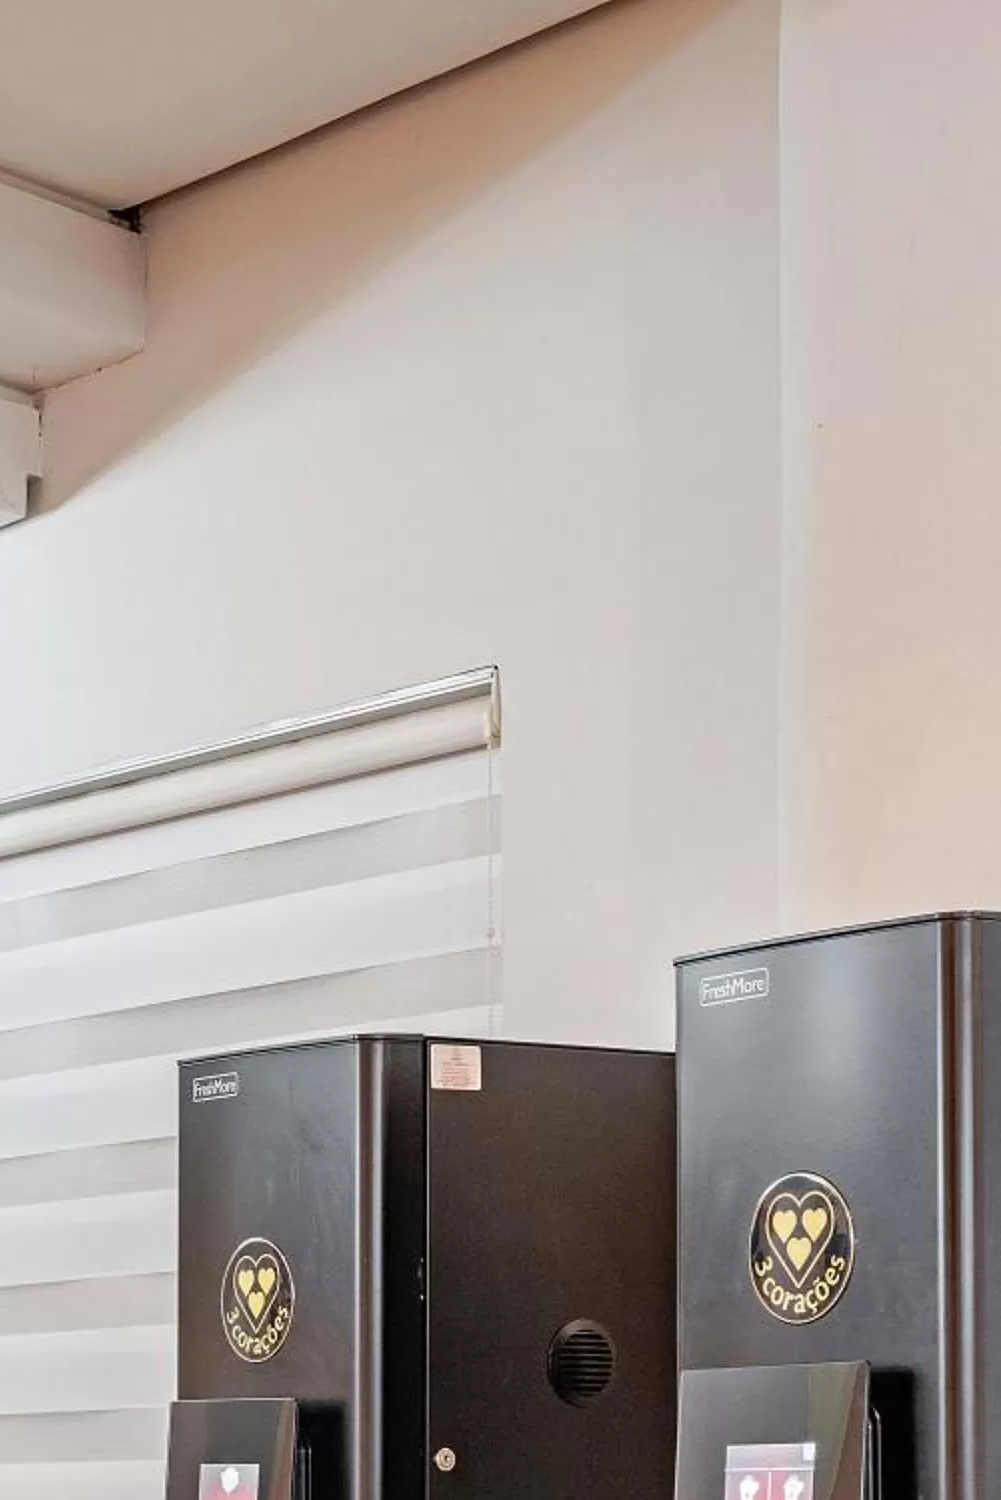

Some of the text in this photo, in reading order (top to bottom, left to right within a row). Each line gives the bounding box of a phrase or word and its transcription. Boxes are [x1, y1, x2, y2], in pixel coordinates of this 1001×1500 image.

[702, 977, 764, 1001] FreshMore
[754, 1254, 845, 1315] 3 corações
[226, 1305, 289, 1355] 3 corações
